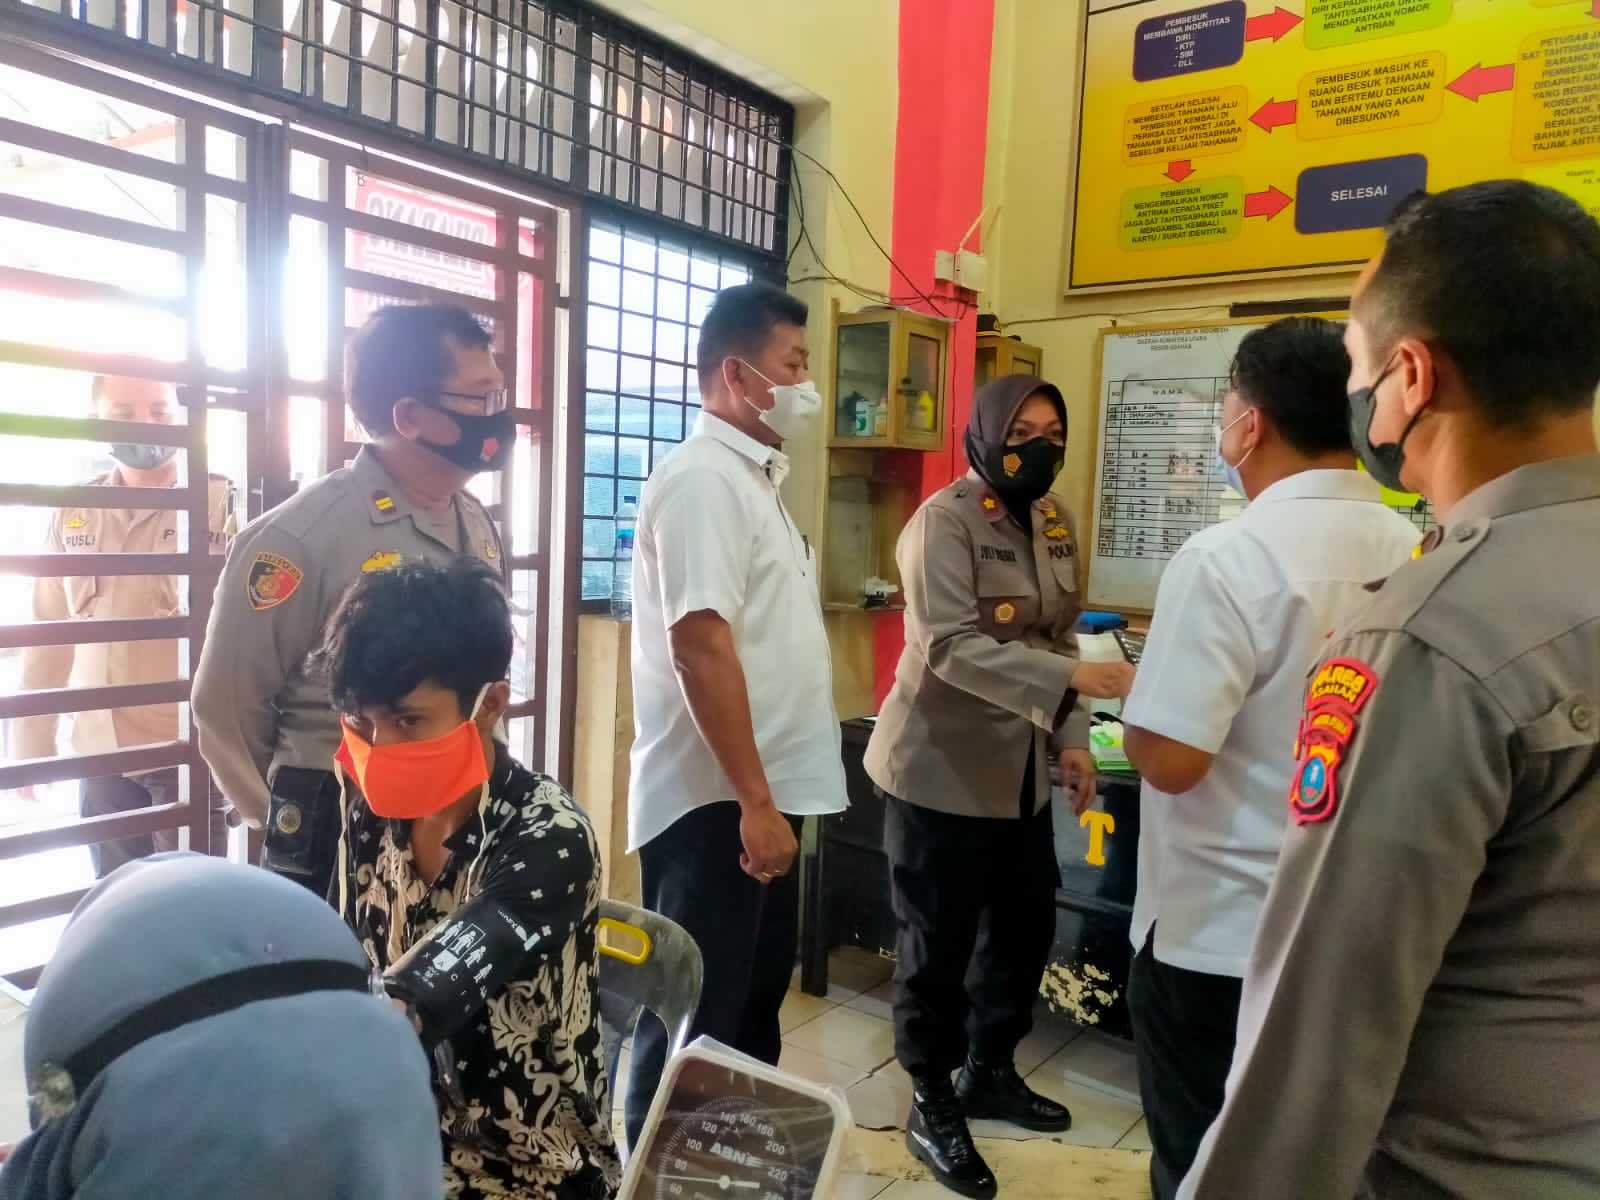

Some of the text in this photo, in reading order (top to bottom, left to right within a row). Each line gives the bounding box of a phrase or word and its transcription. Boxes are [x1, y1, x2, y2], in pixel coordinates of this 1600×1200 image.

[1165, 12, 1208, 27] PEMBESUK
[1324, 3, 1430, 30] MENDAPATKAN NOMOR
[1144, 16, 1231, 40] MEMBAWA INDENTITAS
[1355, 19, 1395, 33] ANTRIAN
[1316, 59, 1429, 86] PEMBESUK MASUK KE
[1309, 69, 1435, 97] RUANG BESUK TAHANAN
[1311, 81, 1431, 109] DAN BERTEMU DENGAN
[1314, 94, 1425, 119] TAHANAN YANG AKAN
[1335, 109, 1400, 126] DIBESUKNYA
[1200, 136, 1238, 148] TAHANAN
[1534, 129, 1570, 141] BAHAN
[1331, 185, 1388, 202] SELESAI
[1080, 810, 1115, 866] T
[720, 1111, 736, 1124] 140
[701, 1121, 717, 1134] 120
[685, 1138, 702, 1152] 100
[765, 1140, 785, 1156] 200
[767, 1166, 787, 1181] 220
